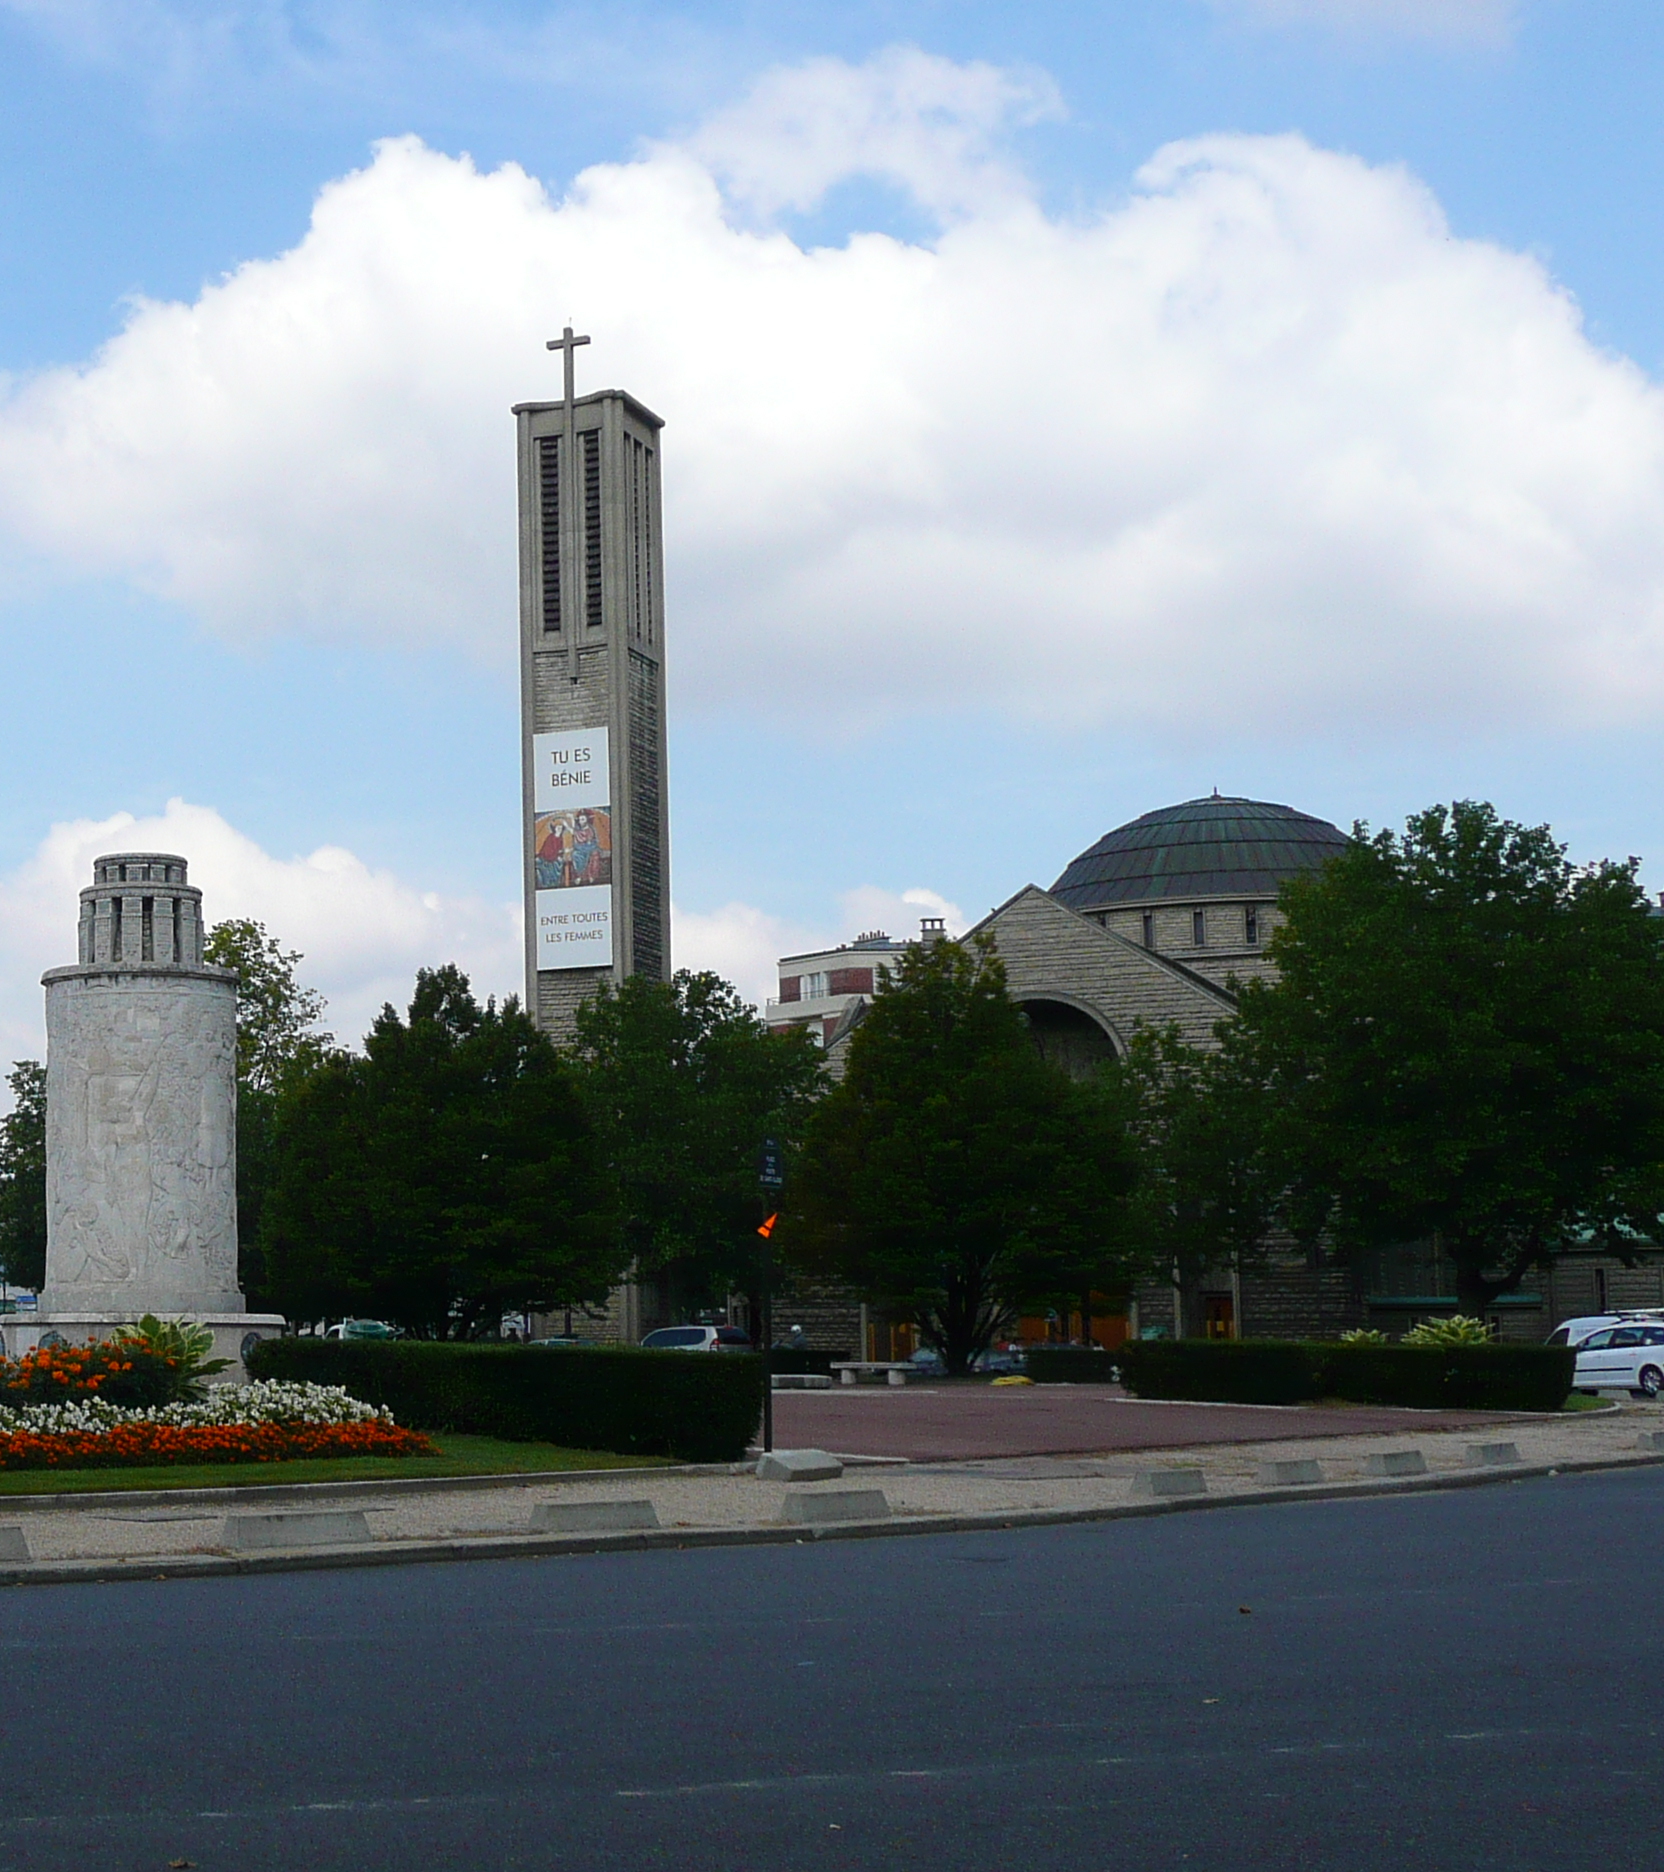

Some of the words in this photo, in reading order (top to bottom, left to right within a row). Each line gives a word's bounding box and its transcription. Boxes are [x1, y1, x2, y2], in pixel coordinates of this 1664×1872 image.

[551, 750, 568, 764] TU
[575, 748, 591, 762] ES
[552, 769, 591, 786] BÉNIE
[541, 915, 568, 926] ENTRE
[572, 912, 608, 923] TOUTES
[546, 933, 561, 943] LES
[565, 930, 603, 941] FEMMES
